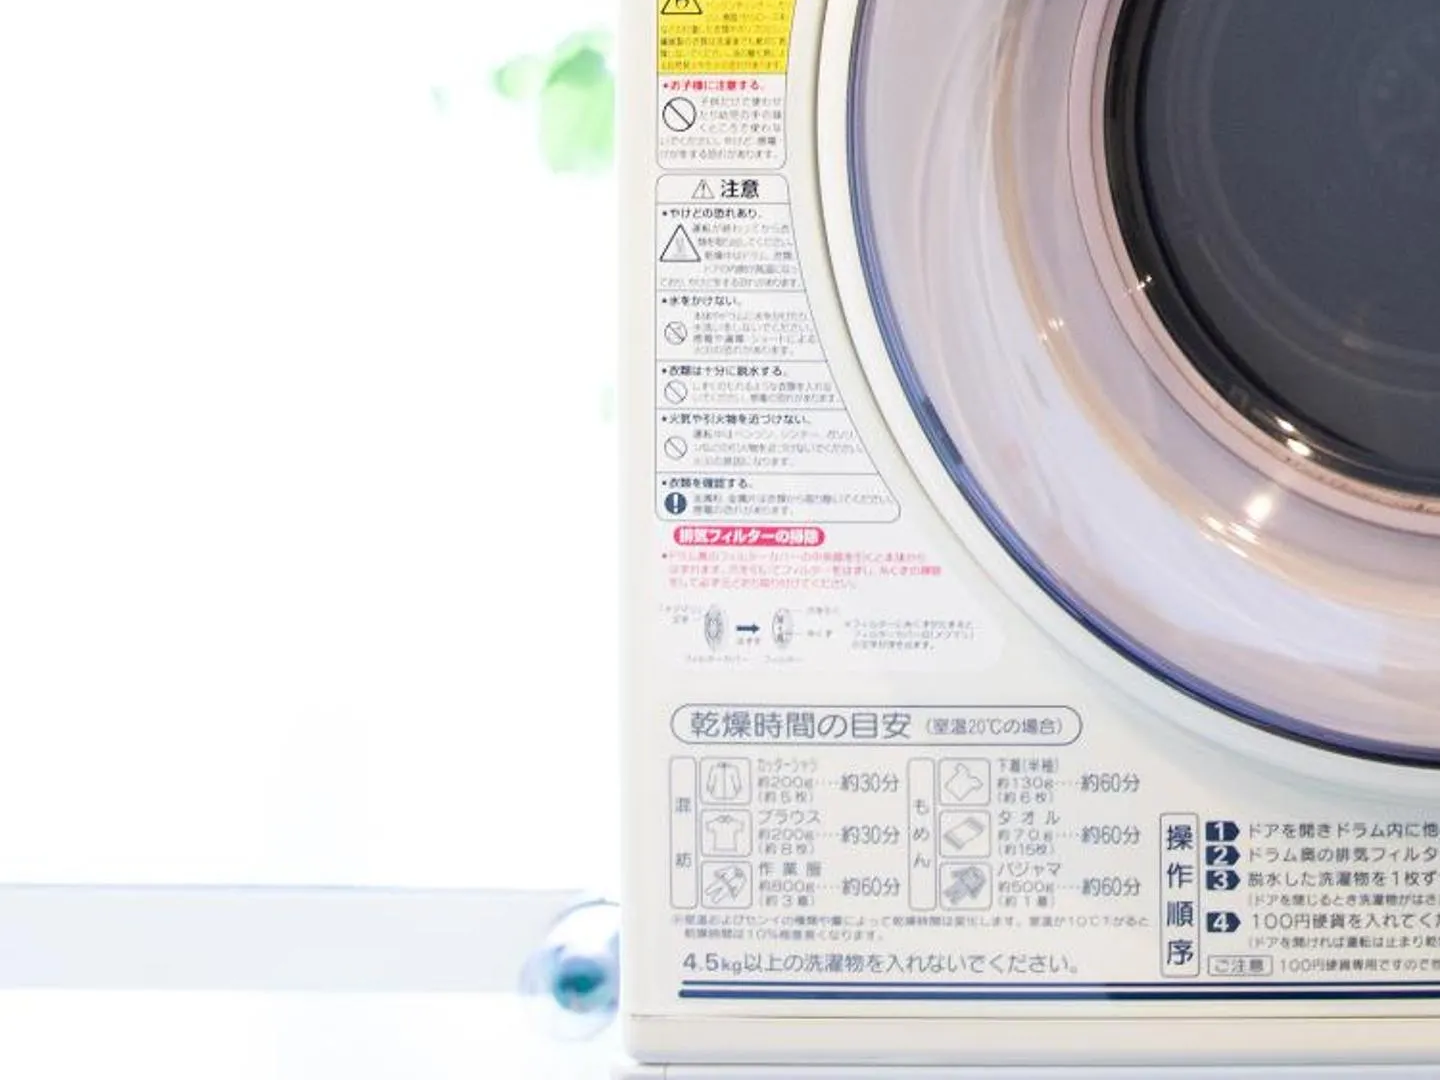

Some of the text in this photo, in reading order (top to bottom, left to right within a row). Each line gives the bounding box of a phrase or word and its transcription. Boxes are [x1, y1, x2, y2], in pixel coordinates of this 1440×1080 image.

[721, 178, 759, 198] 注意
[680, 528, 819, 545] 排気フィルターの掃除
[690, 712, 912, 739] 乾燥時間の目安
[840, 773, 900, 793] 約30分
[1081, 773, 1140, 793] 約60分
[841, 826, 901, 845] 約30分
[1081, 826, 1141, 846] 約60分
[841, 878, 901, 897] 約60分
[1082, 878, 1141, 897] 約60分
[1166, 824, 1194, 966] 操作順序
